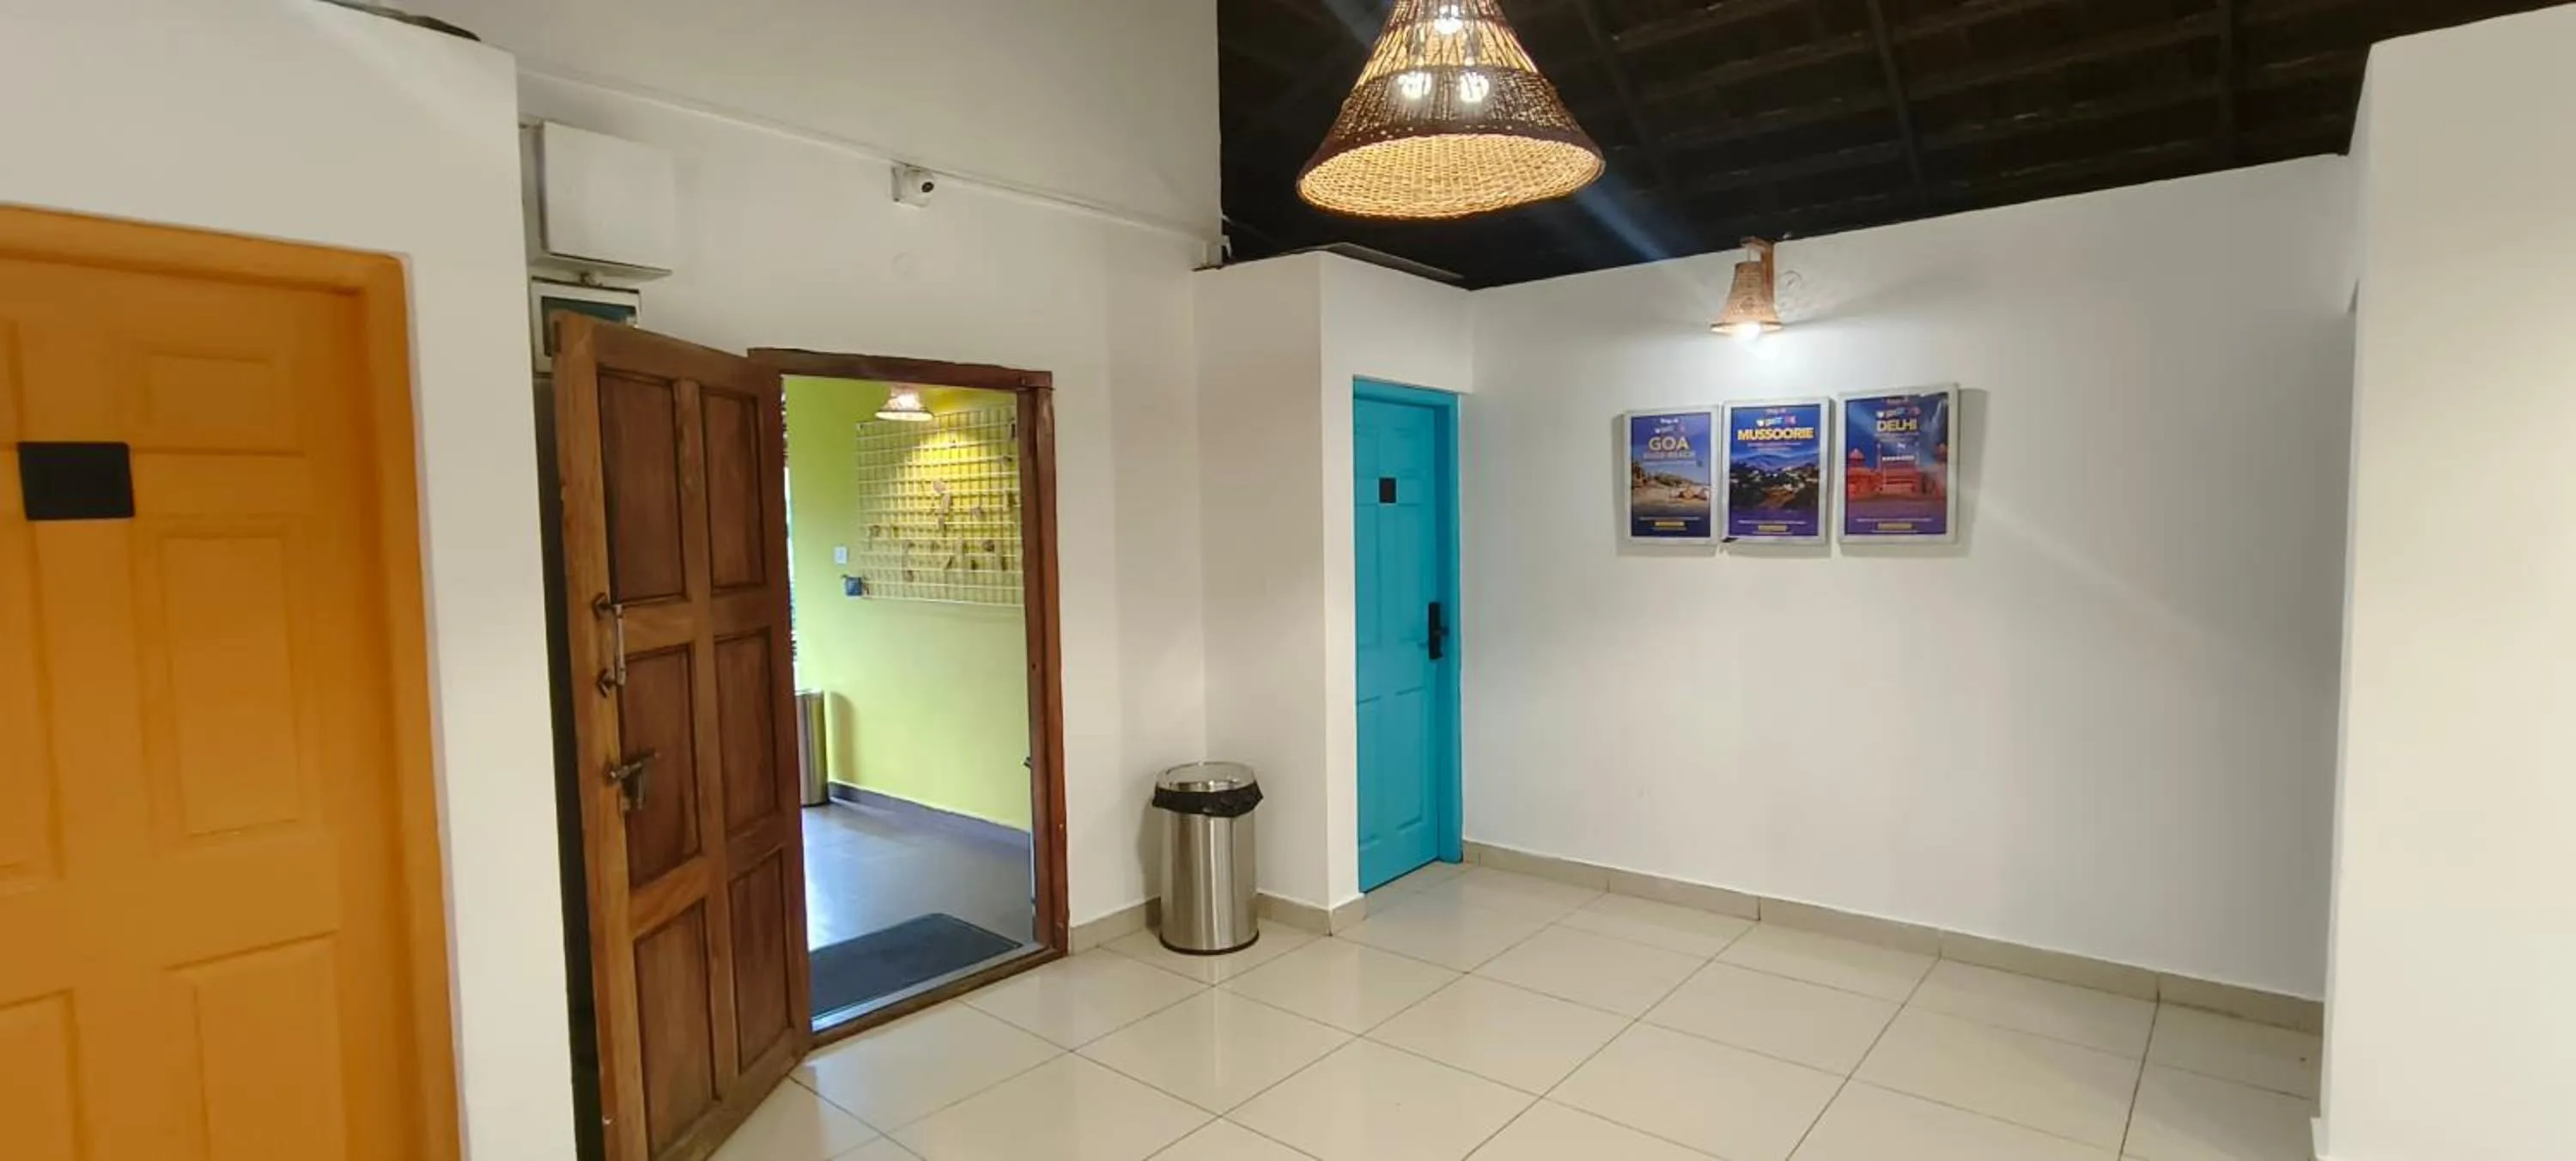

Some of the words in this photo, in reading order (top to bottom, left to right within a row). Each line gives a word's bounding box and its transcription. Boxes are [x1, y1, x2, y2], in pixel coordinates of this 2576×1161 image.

[1876, 418, 1917, 432] DELHI
[1737, 428, 1814, 441] MUSSOORIE
[1649, 436, 1691, 451] GOA
